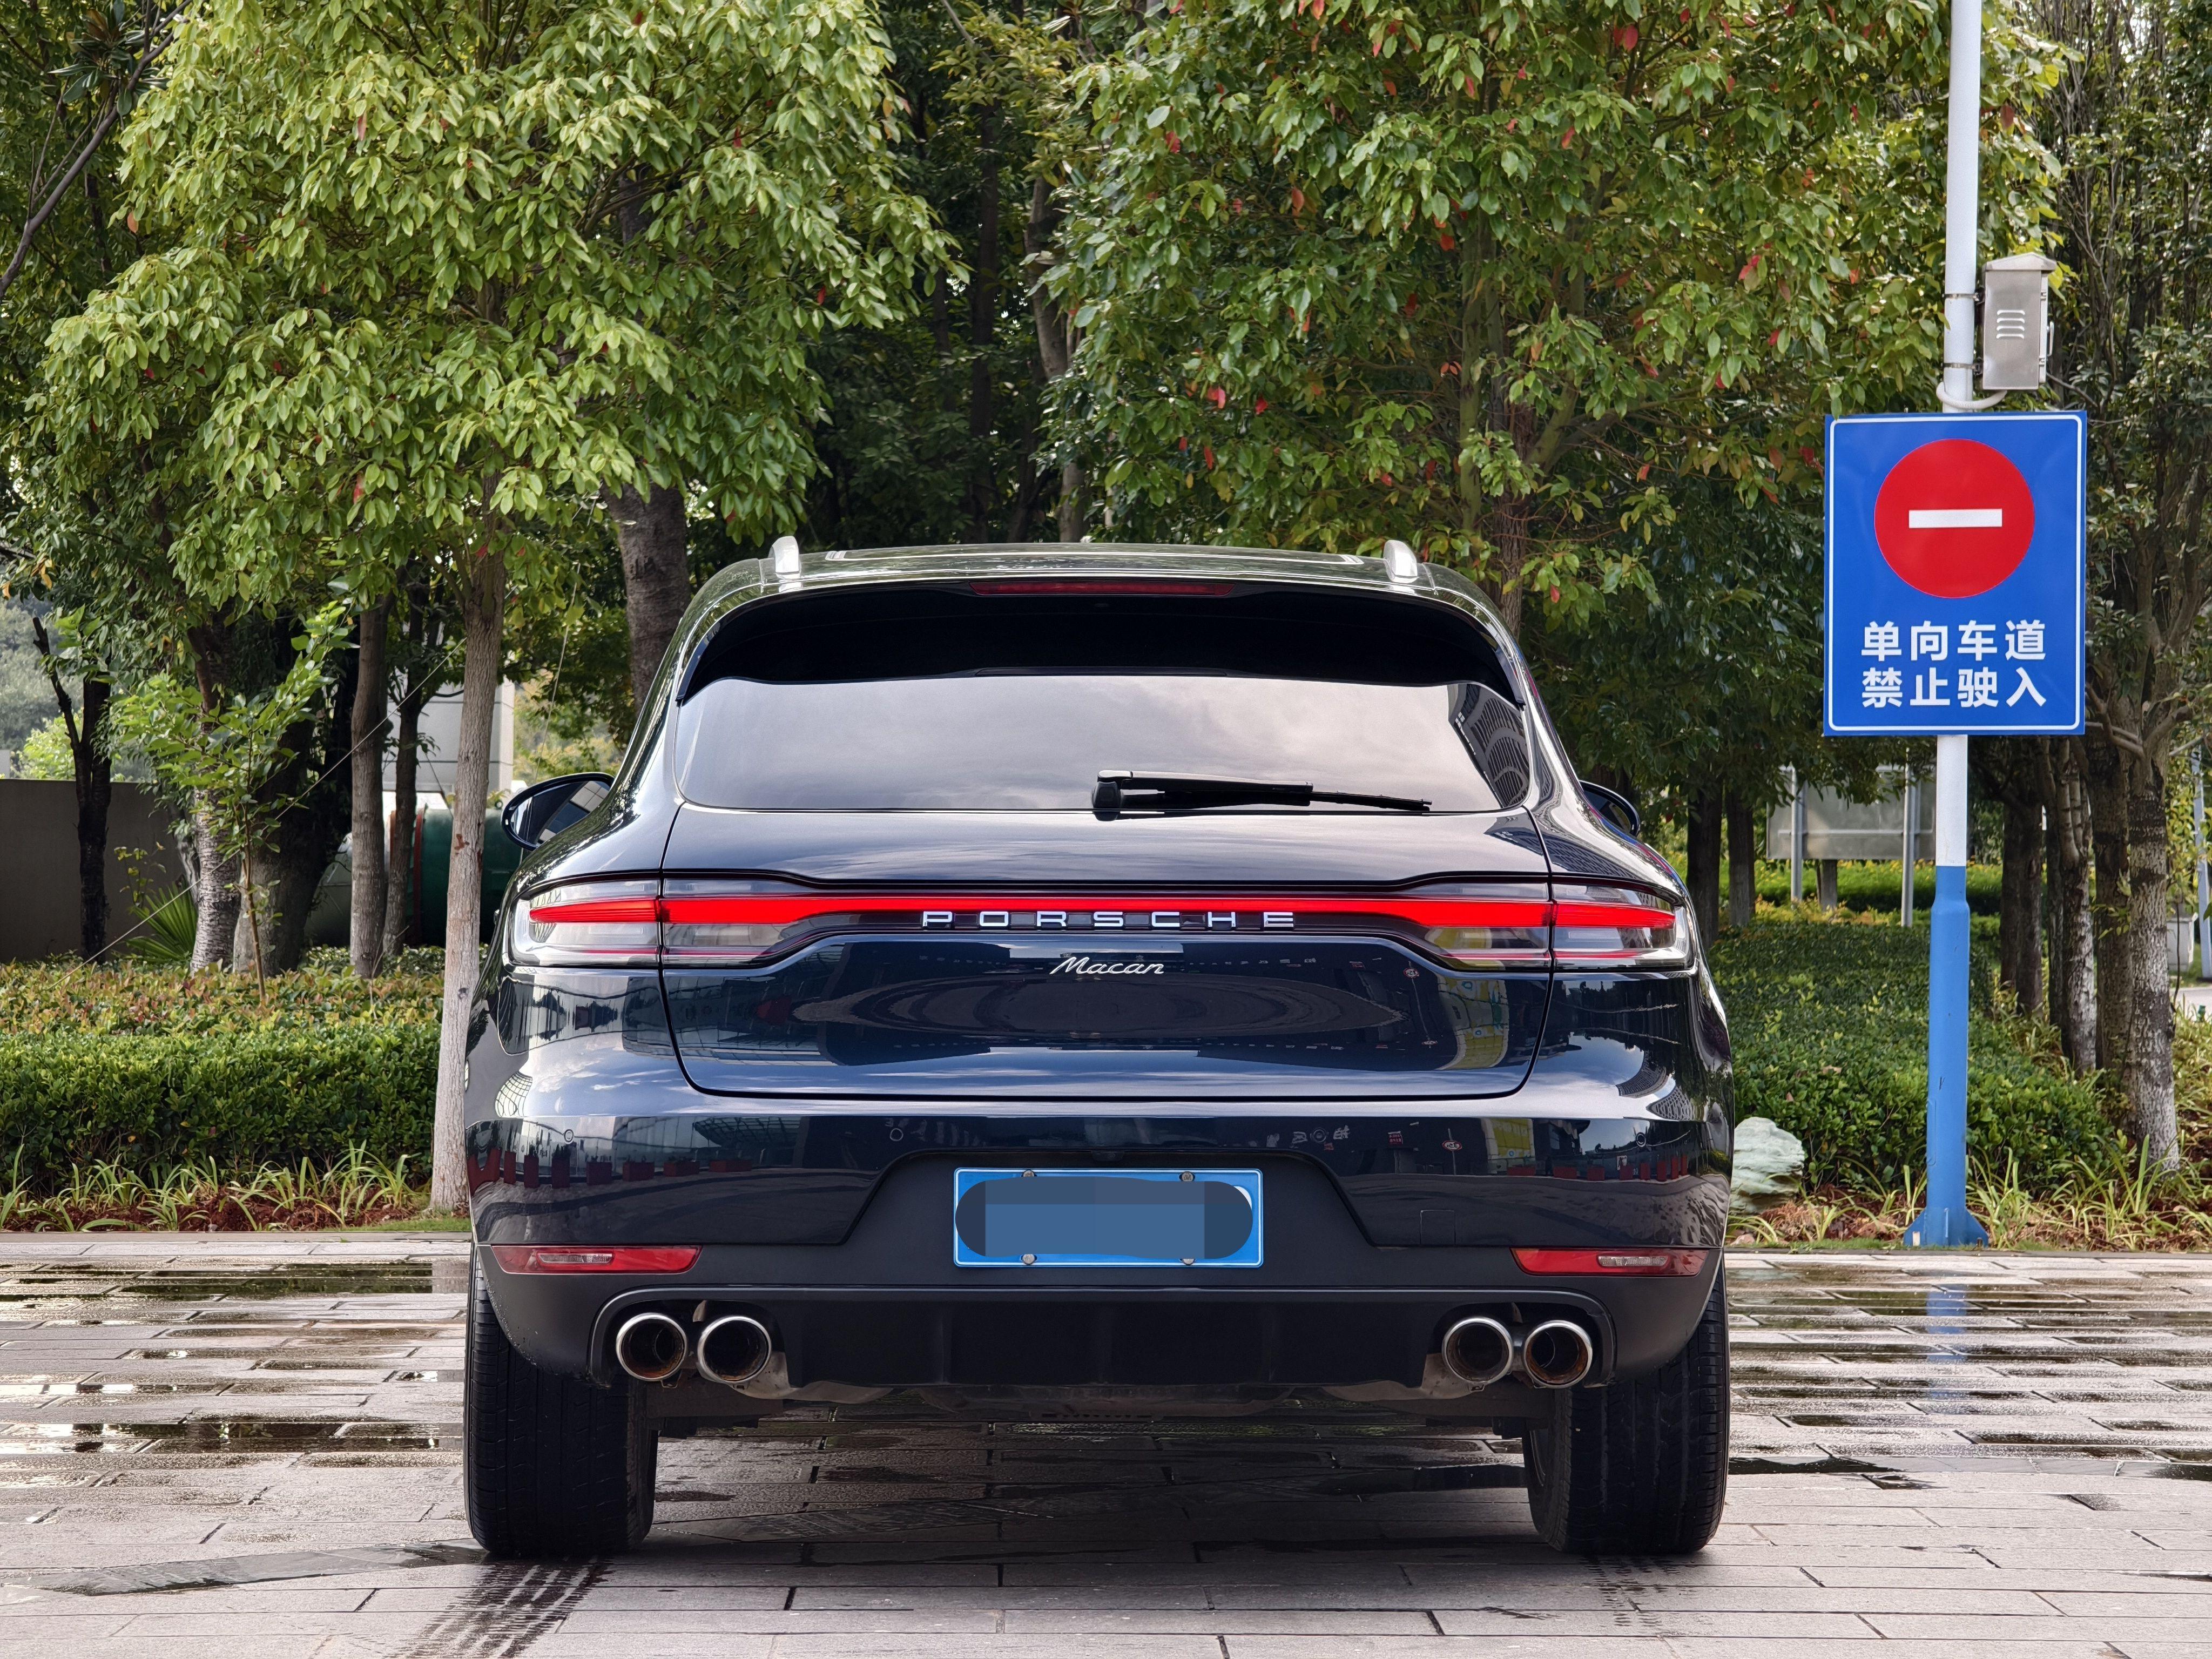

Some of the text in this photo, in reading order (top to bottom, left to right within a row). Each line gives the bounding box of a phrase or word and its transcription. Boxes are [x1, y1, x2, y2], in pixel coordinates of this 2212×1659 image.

[1861, 619, 2046, 662] 单向车道
[1862, 667, 2047, 708] 禁止驶入
[922, 911, 1294, 927] PORSCHE
[1049, 956, 1164, 975] Macan
